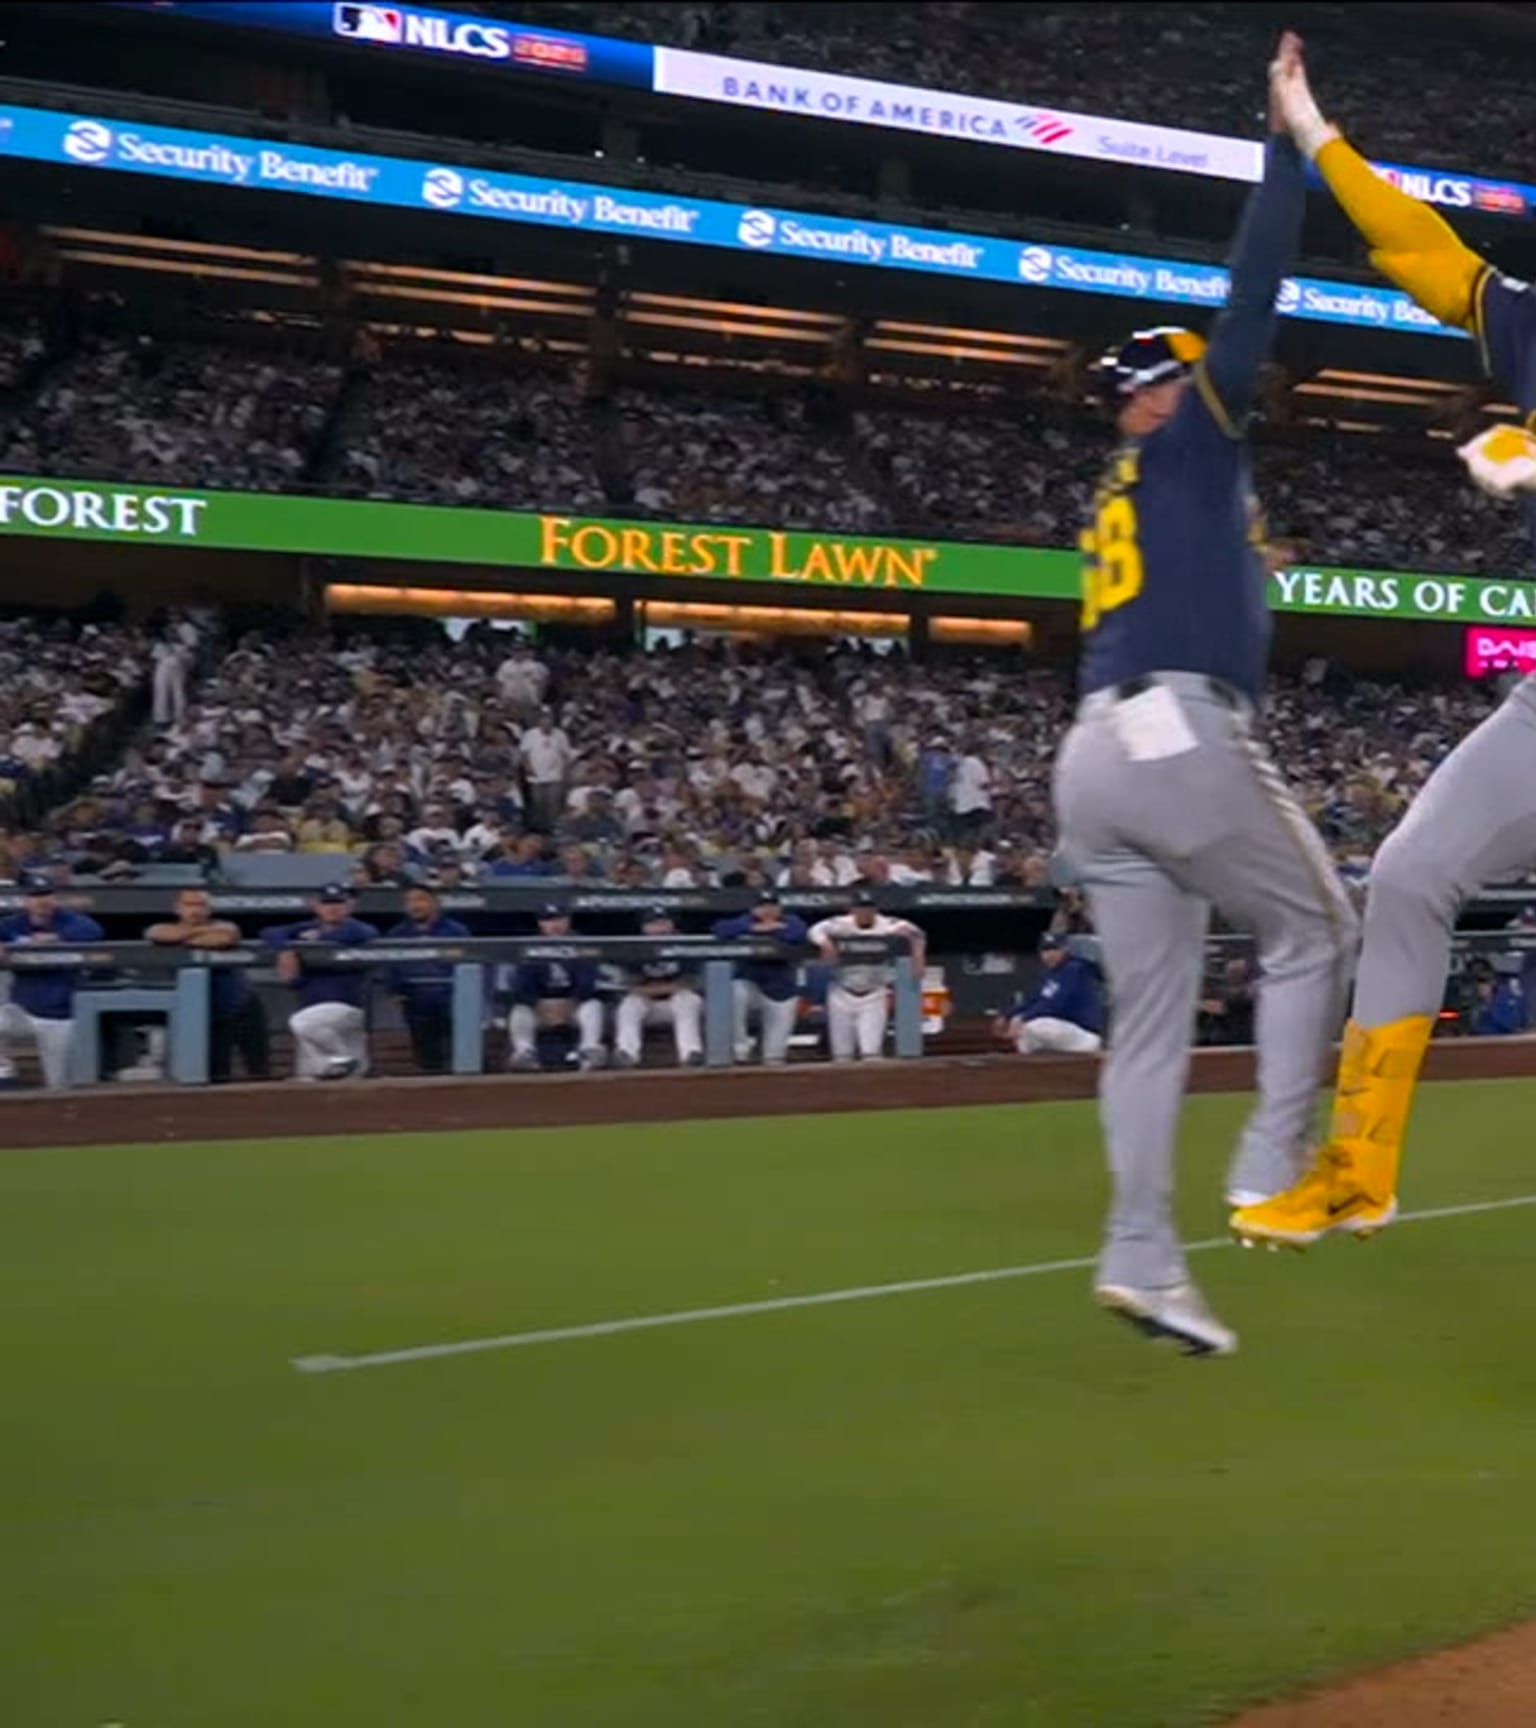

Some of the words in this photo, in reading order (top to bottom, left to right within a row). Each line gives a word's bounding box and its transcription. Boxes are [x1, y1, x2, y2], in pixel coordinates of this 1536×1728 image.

[405, 15, 510, 58] NLCS
[721, 76, 810, 110] BANK
[821, 90, 860, 115] OF
[870, 100, 1008, 138] AMERICA
[118, 134, 251, 184] Security
[259, 153, 373, 192] Benefit
[1098, 135, 1150, 161] Suite
[1155, 147, 1208, 168] Level
[468, 180, 588, 225] Security
[593, 196, 691, 232] Benefit
[1402, 173, 1472, 207] NLCS
[779, 220, 885, 261] Security
[890, 236, 980, 269] Benefit
[1055, 255, 1148, 295] Security
[1304, 288, 1391, 323] Security
[0, 486, 207, 536] FOREST
[540, 515, 750, 577] FOREST
[769, 532, 926, 587] LAWN
[1081, 496, 1144, 631] 8
[1273, 569, 1398, 611] YEARS
[1413, 579, 1464, 613] OF
